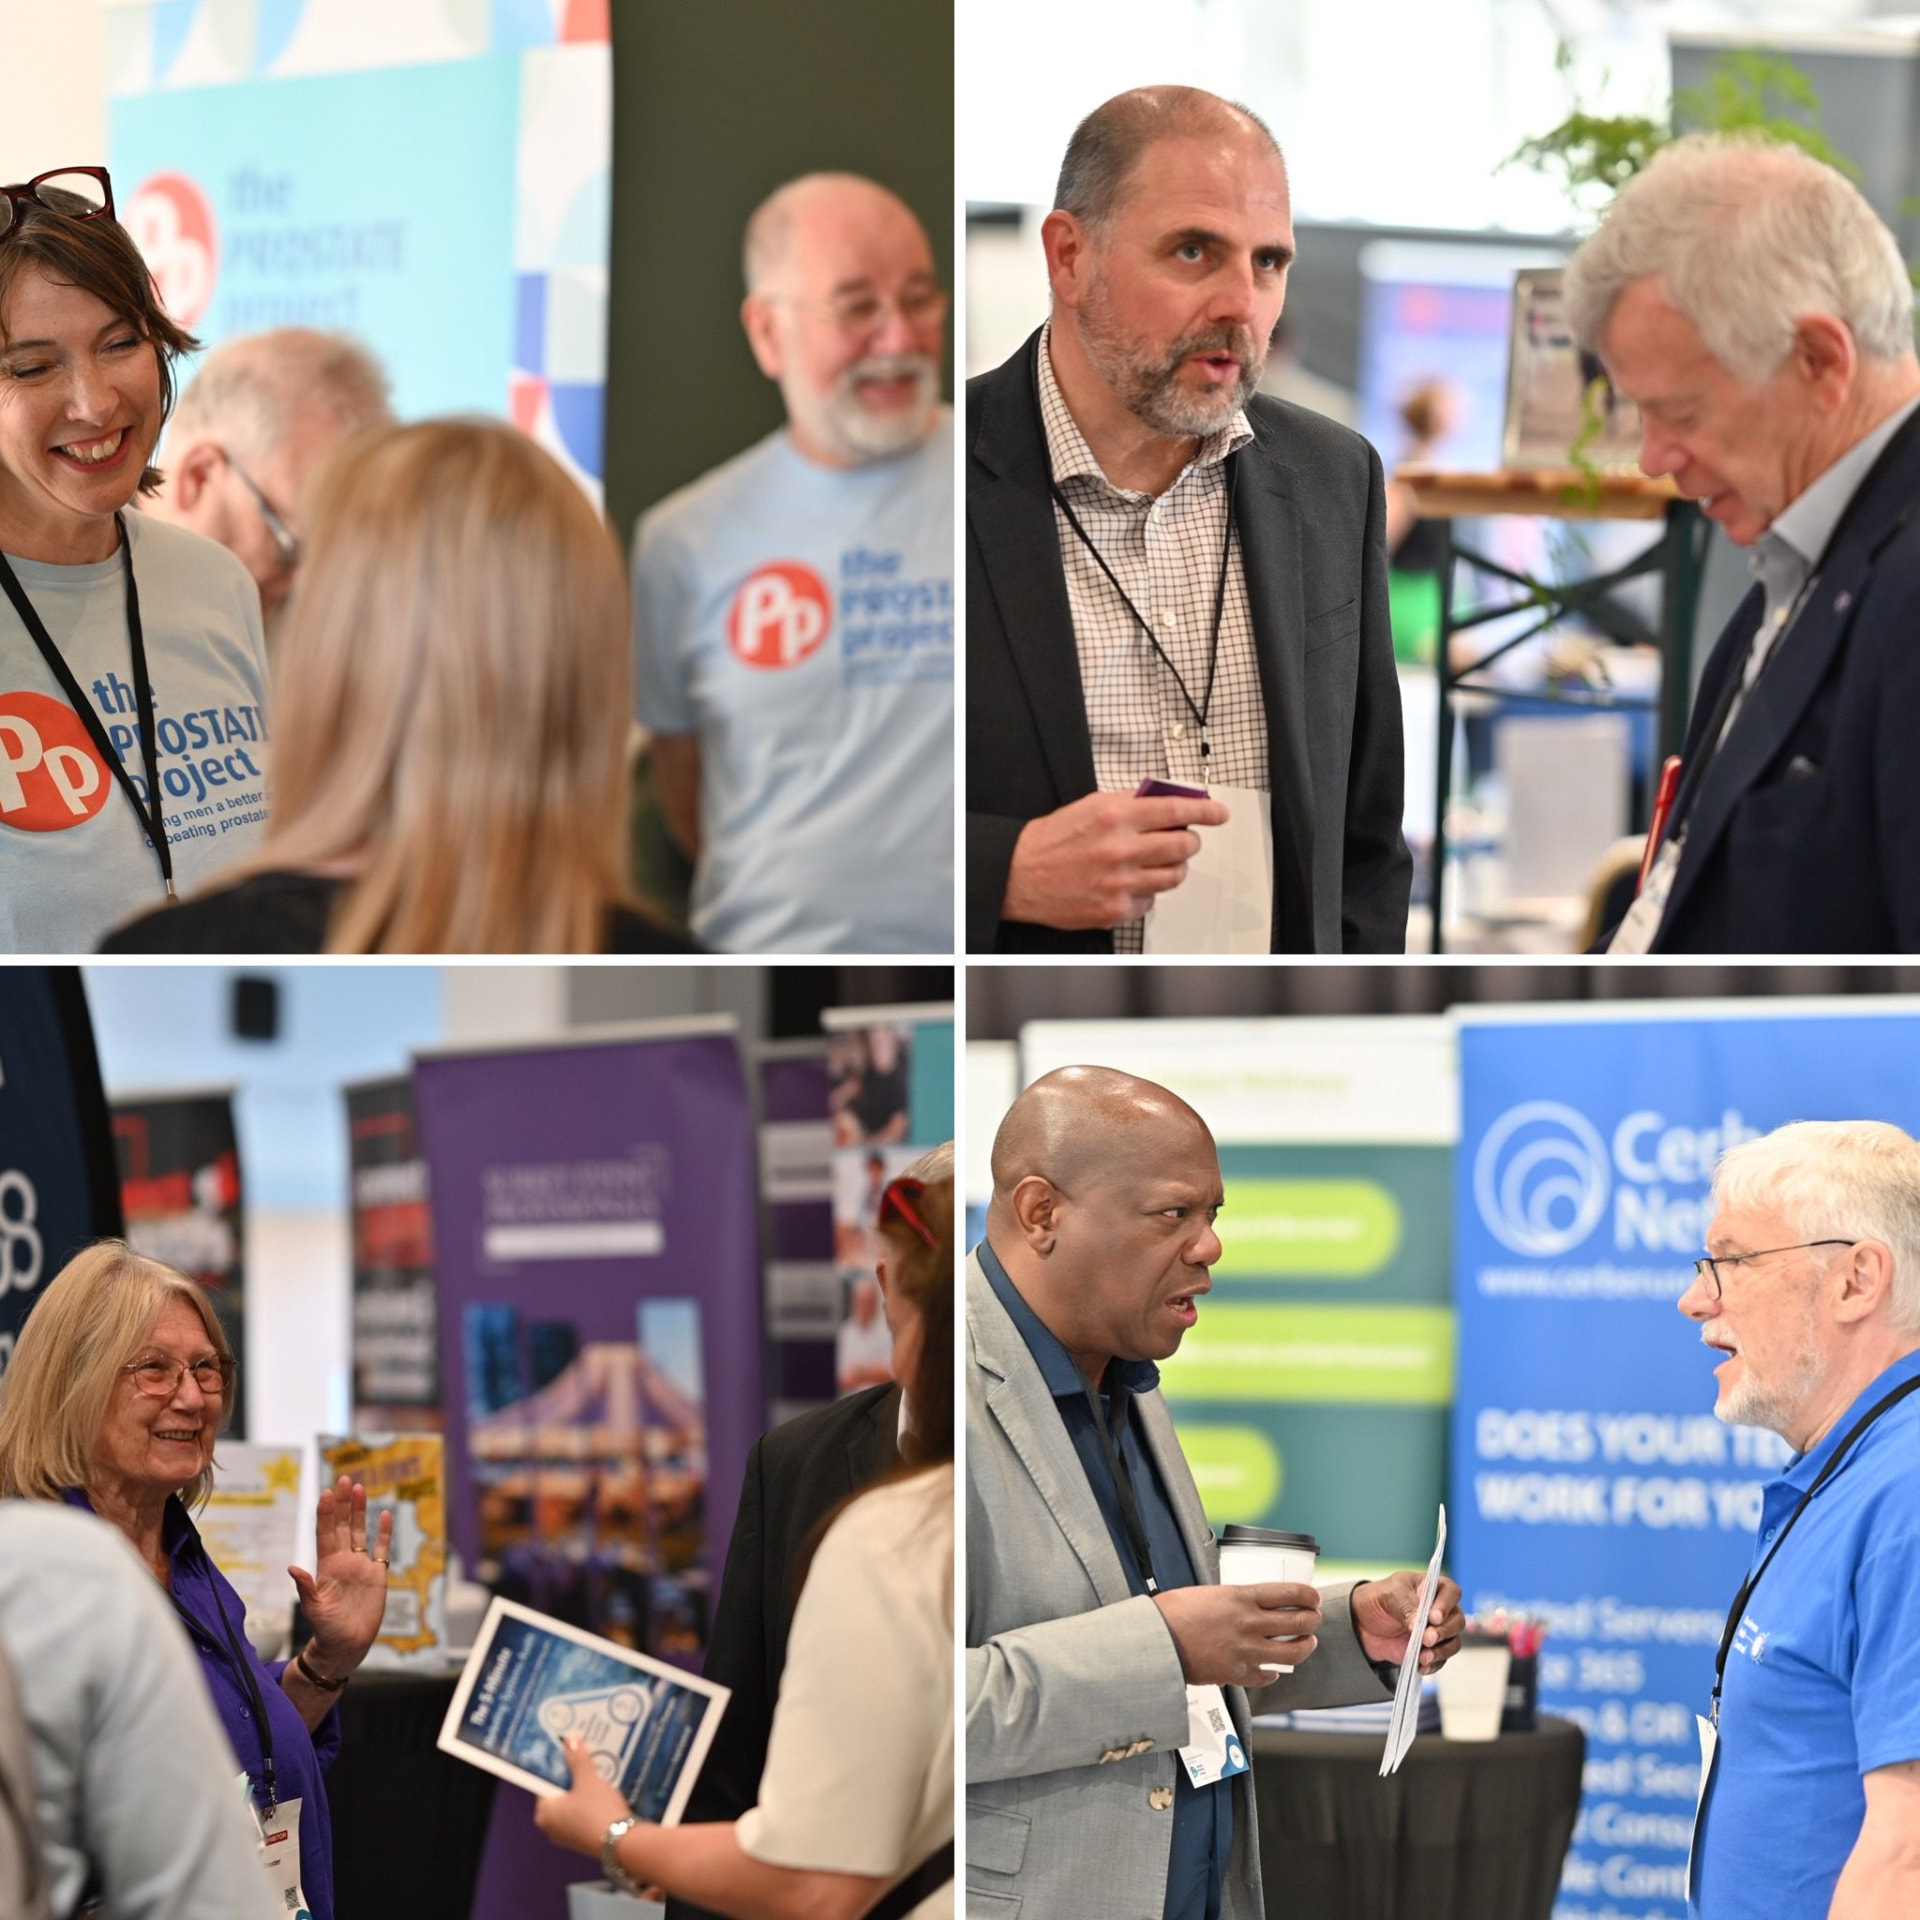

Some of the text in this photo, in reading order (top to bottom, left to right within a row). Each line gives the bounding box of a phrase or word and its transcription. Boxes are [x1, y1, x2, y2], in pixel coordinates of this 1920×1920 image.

[738, 573, 824, 662] Pp
[0, 714, 99, 816] Pp
[183, 805, 214, 821] men
[216, 802, 226, 812] a
[225, 791, 263, 809] better
[1475, 1408, 1593, 1462] DOES
[1600, 1411, 1723, 1466] YOUR
[1473, 1471, 1606, 1525] WORK
[1613, 1475, 1708, 1531] FOR
